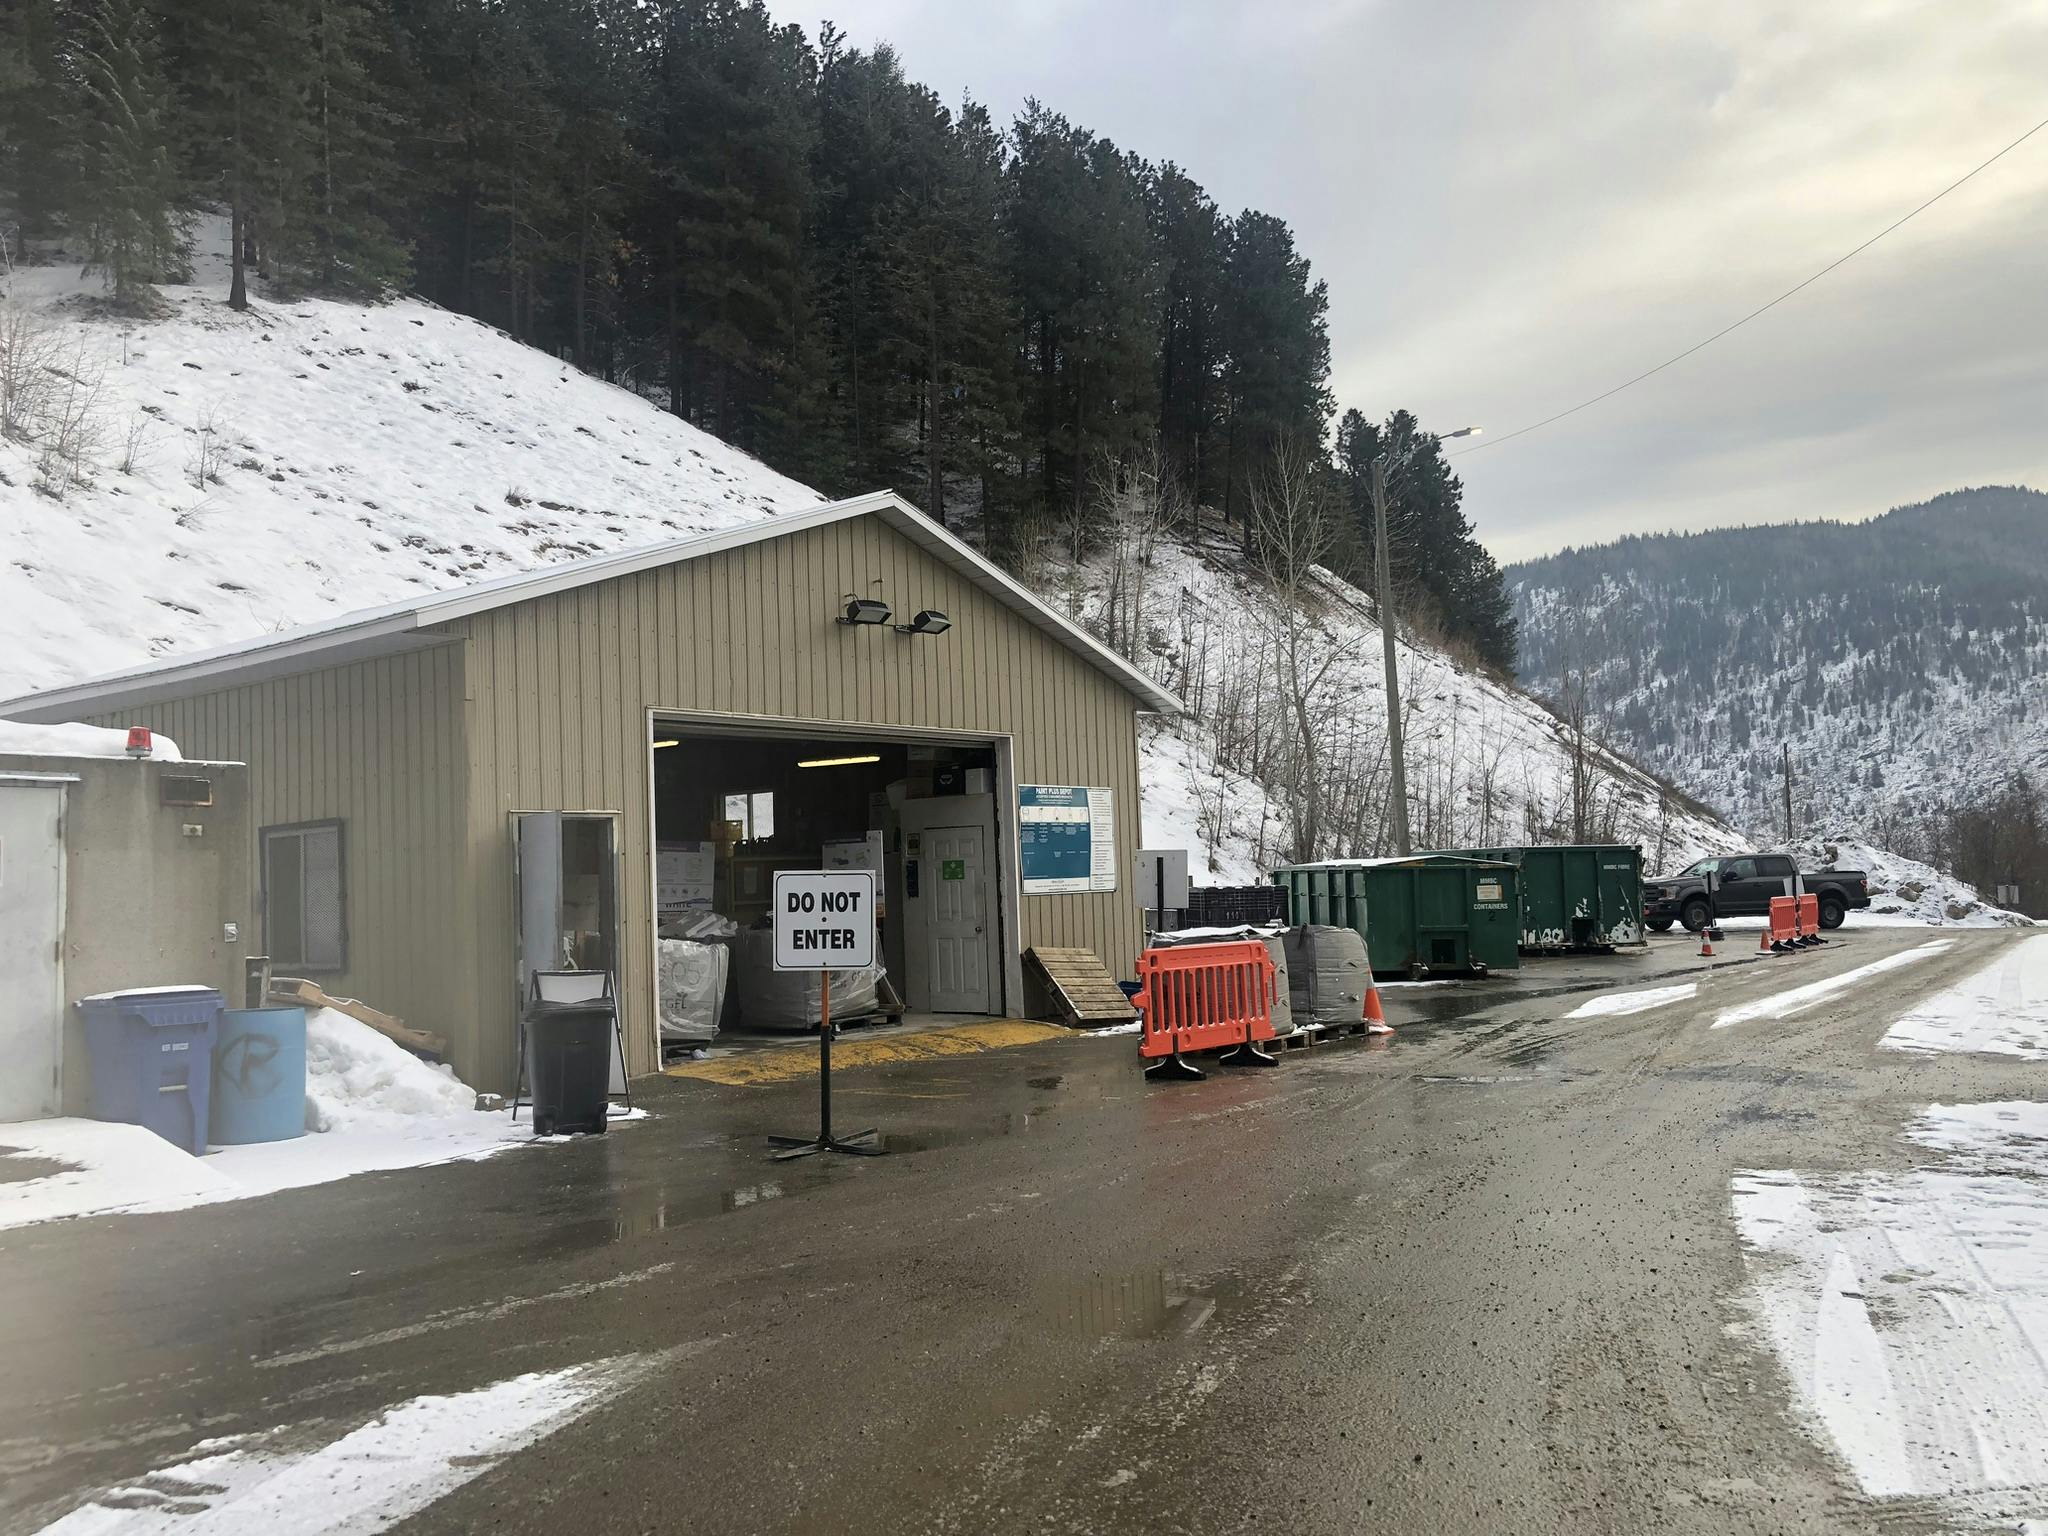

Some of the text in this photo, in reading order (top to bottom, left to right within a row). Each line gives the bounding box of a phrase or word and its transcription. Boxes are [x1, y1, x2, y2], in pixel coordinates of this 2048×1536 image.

[788, 891, 861, 913] DO NOT
[793, 929, 855, 950] ENTER
